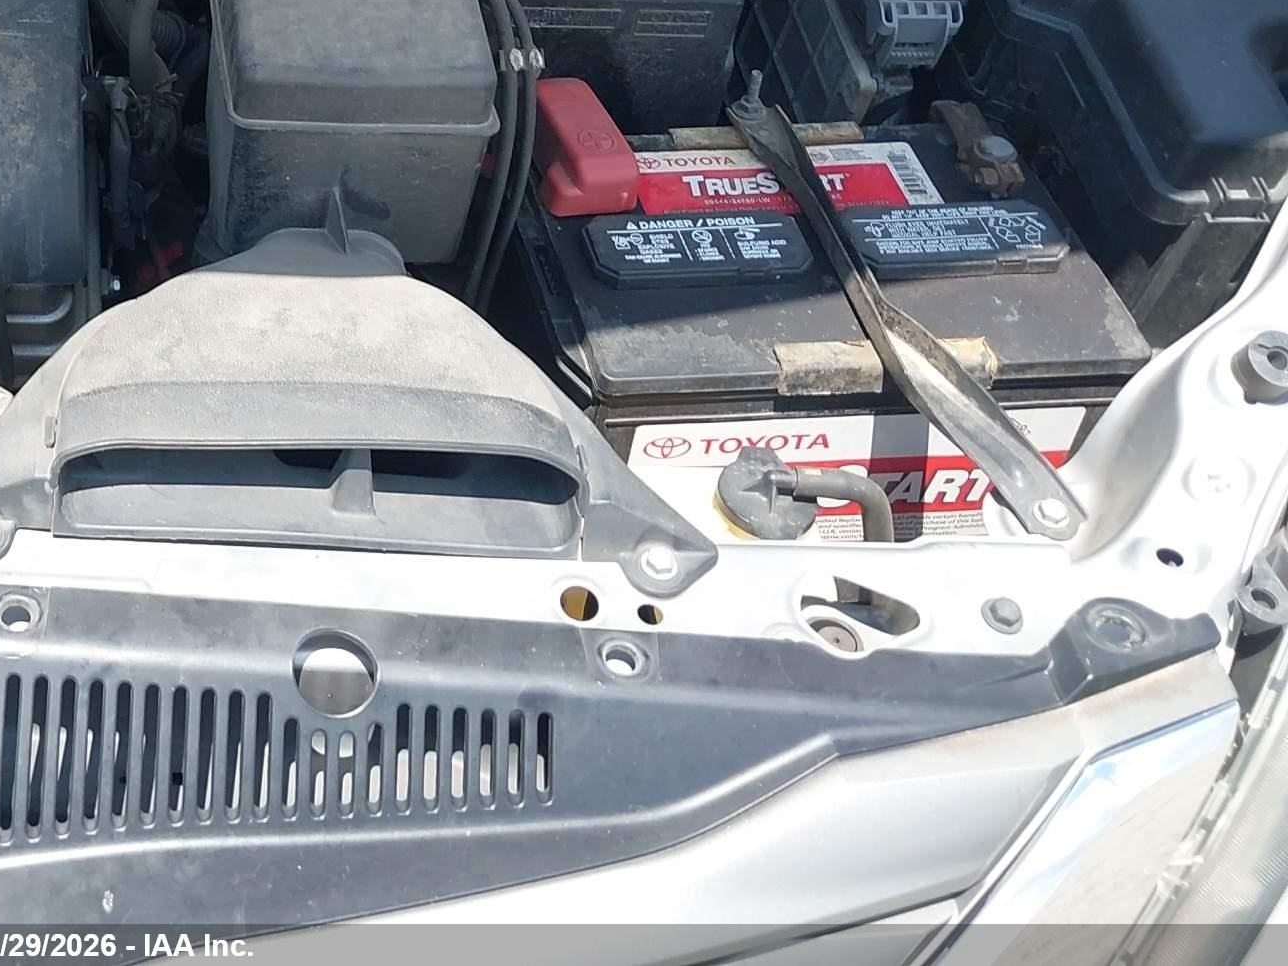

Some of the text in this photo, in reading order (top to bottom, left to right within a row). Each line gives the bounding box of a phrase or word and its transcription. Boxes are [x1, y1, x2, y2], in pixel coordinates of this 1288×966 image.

[664, 156, 737, 167] TOYOTA
[638, 219, 694, 230] DANGER
[705, 216, 756, 227] POISON
[700, 433, 830, 455] TOYOTA
